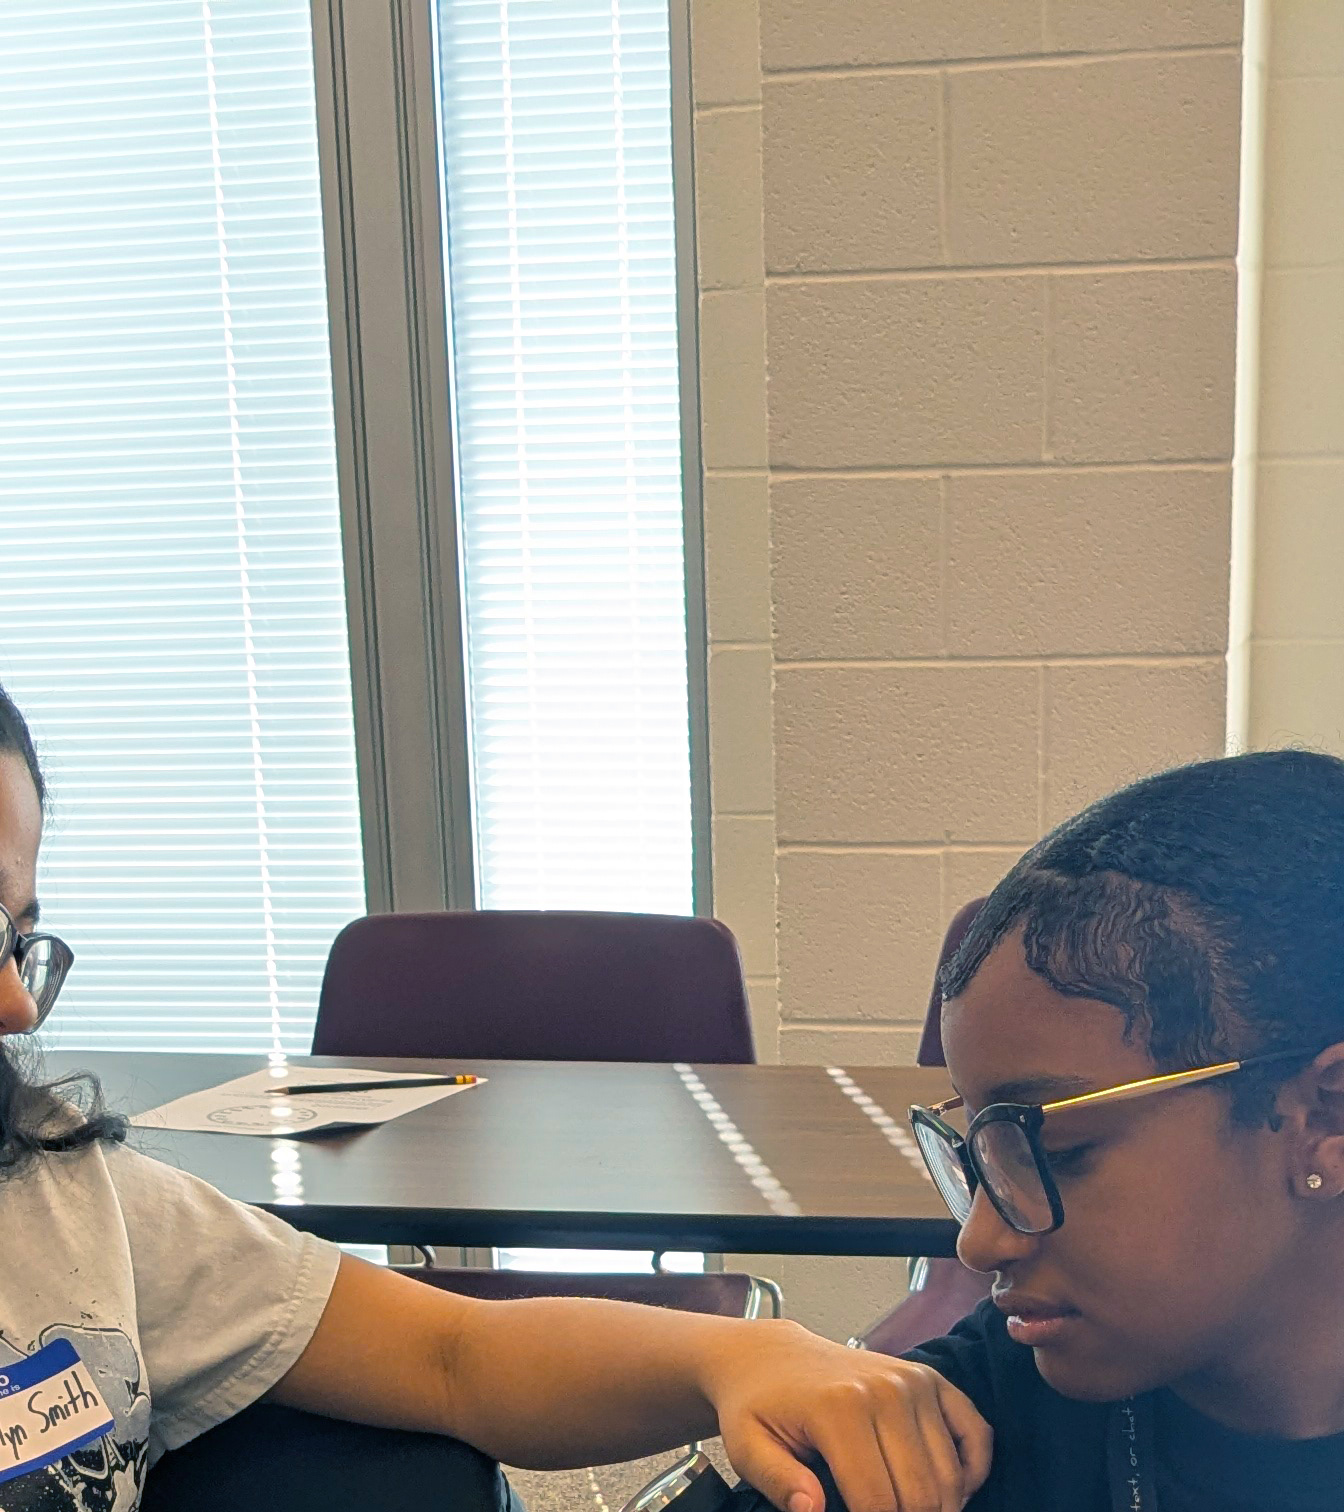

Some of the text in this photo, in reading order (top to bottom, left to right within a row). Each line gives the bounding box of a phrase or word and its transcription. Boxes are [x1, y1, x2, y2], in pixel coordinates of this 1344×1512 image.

[11, 1383, 21, 1394] is
[28, 1370, 100, 1434] Smith
[1130, 1447, 1138, 1467] or
